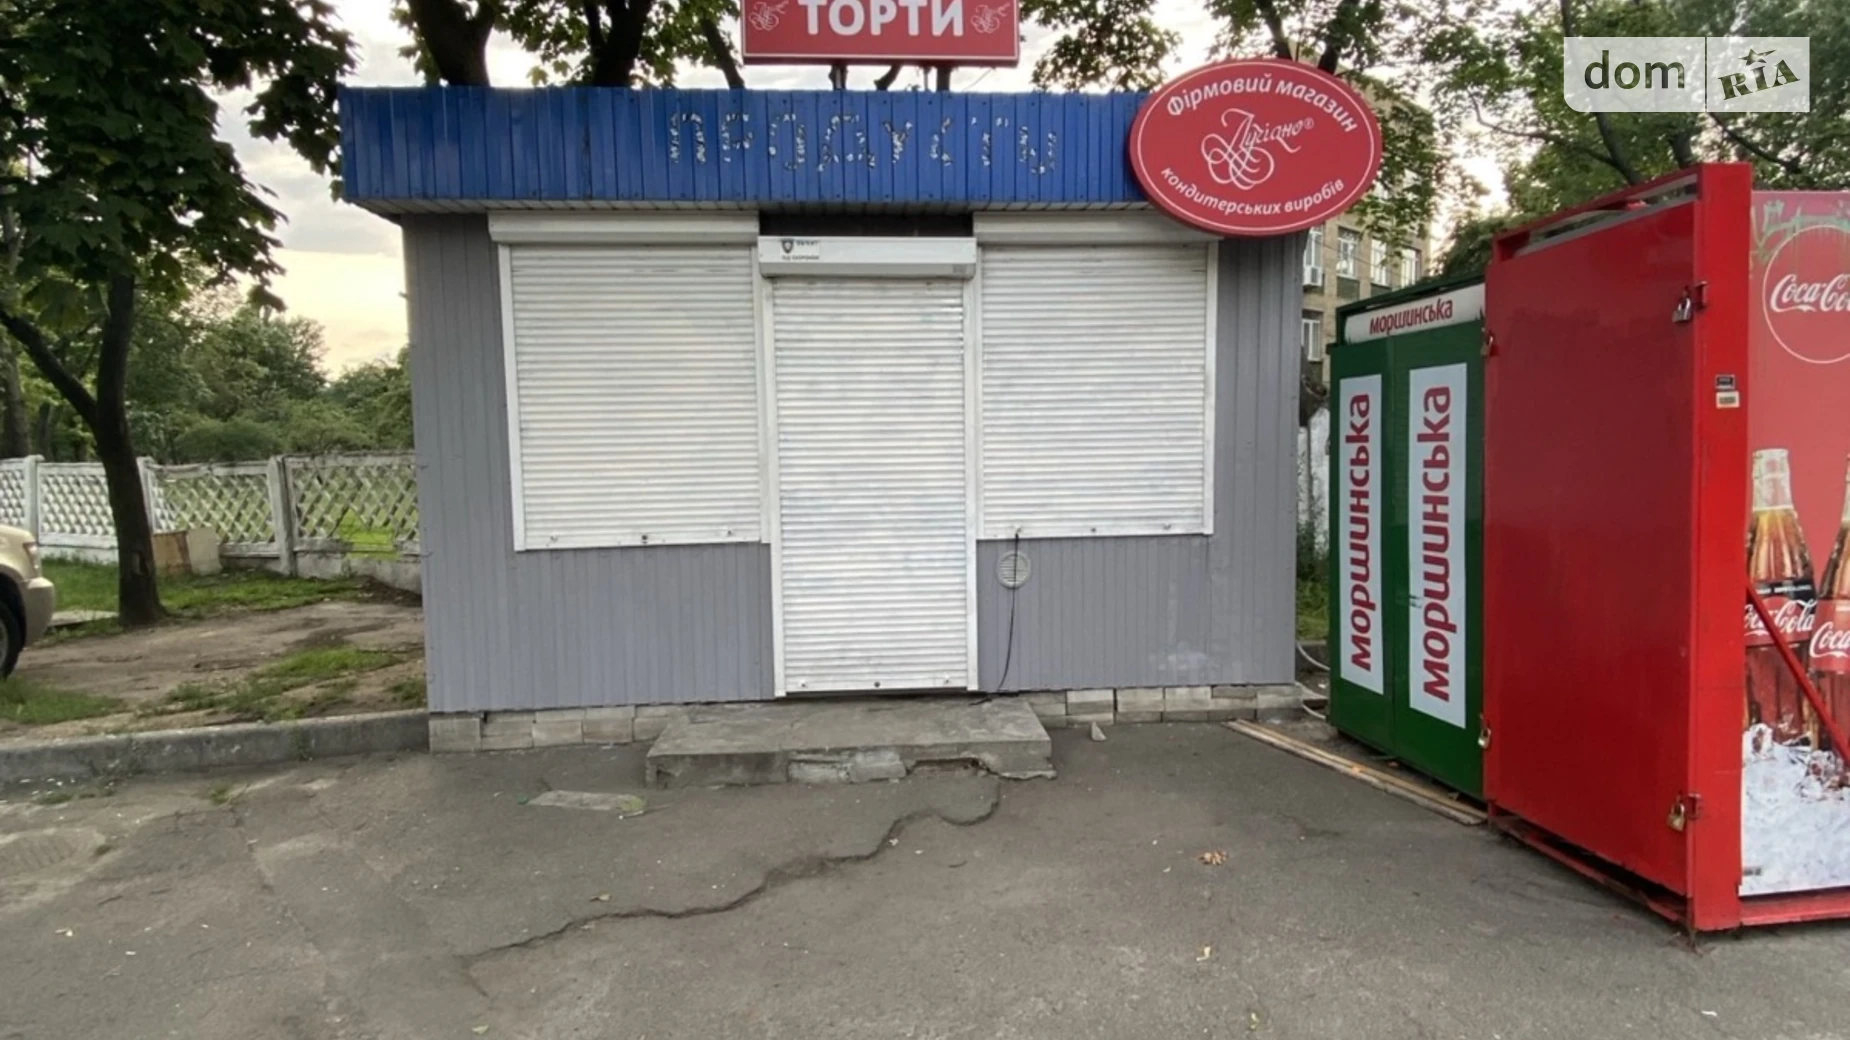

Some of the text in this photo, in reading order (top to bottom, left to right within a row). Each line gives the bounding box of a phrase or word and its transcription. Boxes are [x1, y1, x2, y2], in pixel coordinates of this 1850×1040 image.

[798, 0, 964, 36] ТОРТИ
[1167, 73, 1358, 133] Фірмовий магазин
[1161, 167, 1345, 216] кондитерських виробів
[1369, 298, 1453, 336] моршинська
[1770, 273, 1850, 313] Coca-Co
[1344, 393, 1376, 673] моршинська
[1416, 385, 1458, 702] моршинська
